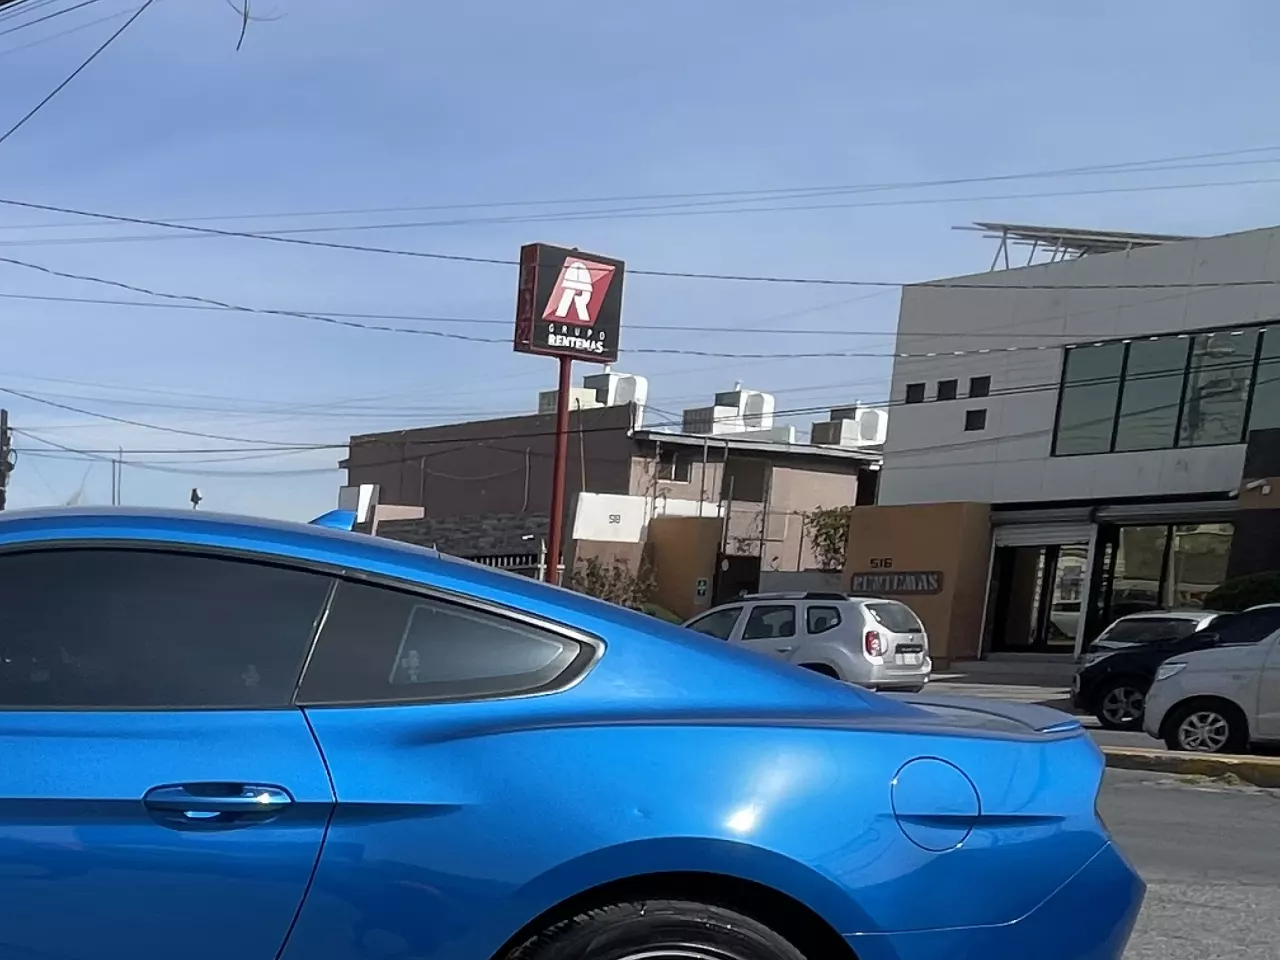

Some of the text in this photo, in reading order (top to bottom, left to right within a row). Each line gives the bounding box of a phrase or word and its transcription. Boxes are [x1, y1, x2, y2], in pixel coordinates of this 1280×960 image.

[548, 322, 606, 341] GRUPO
[548, 333, 605, 353] RENTEMAS
[870, 557, 893, 569] 516
